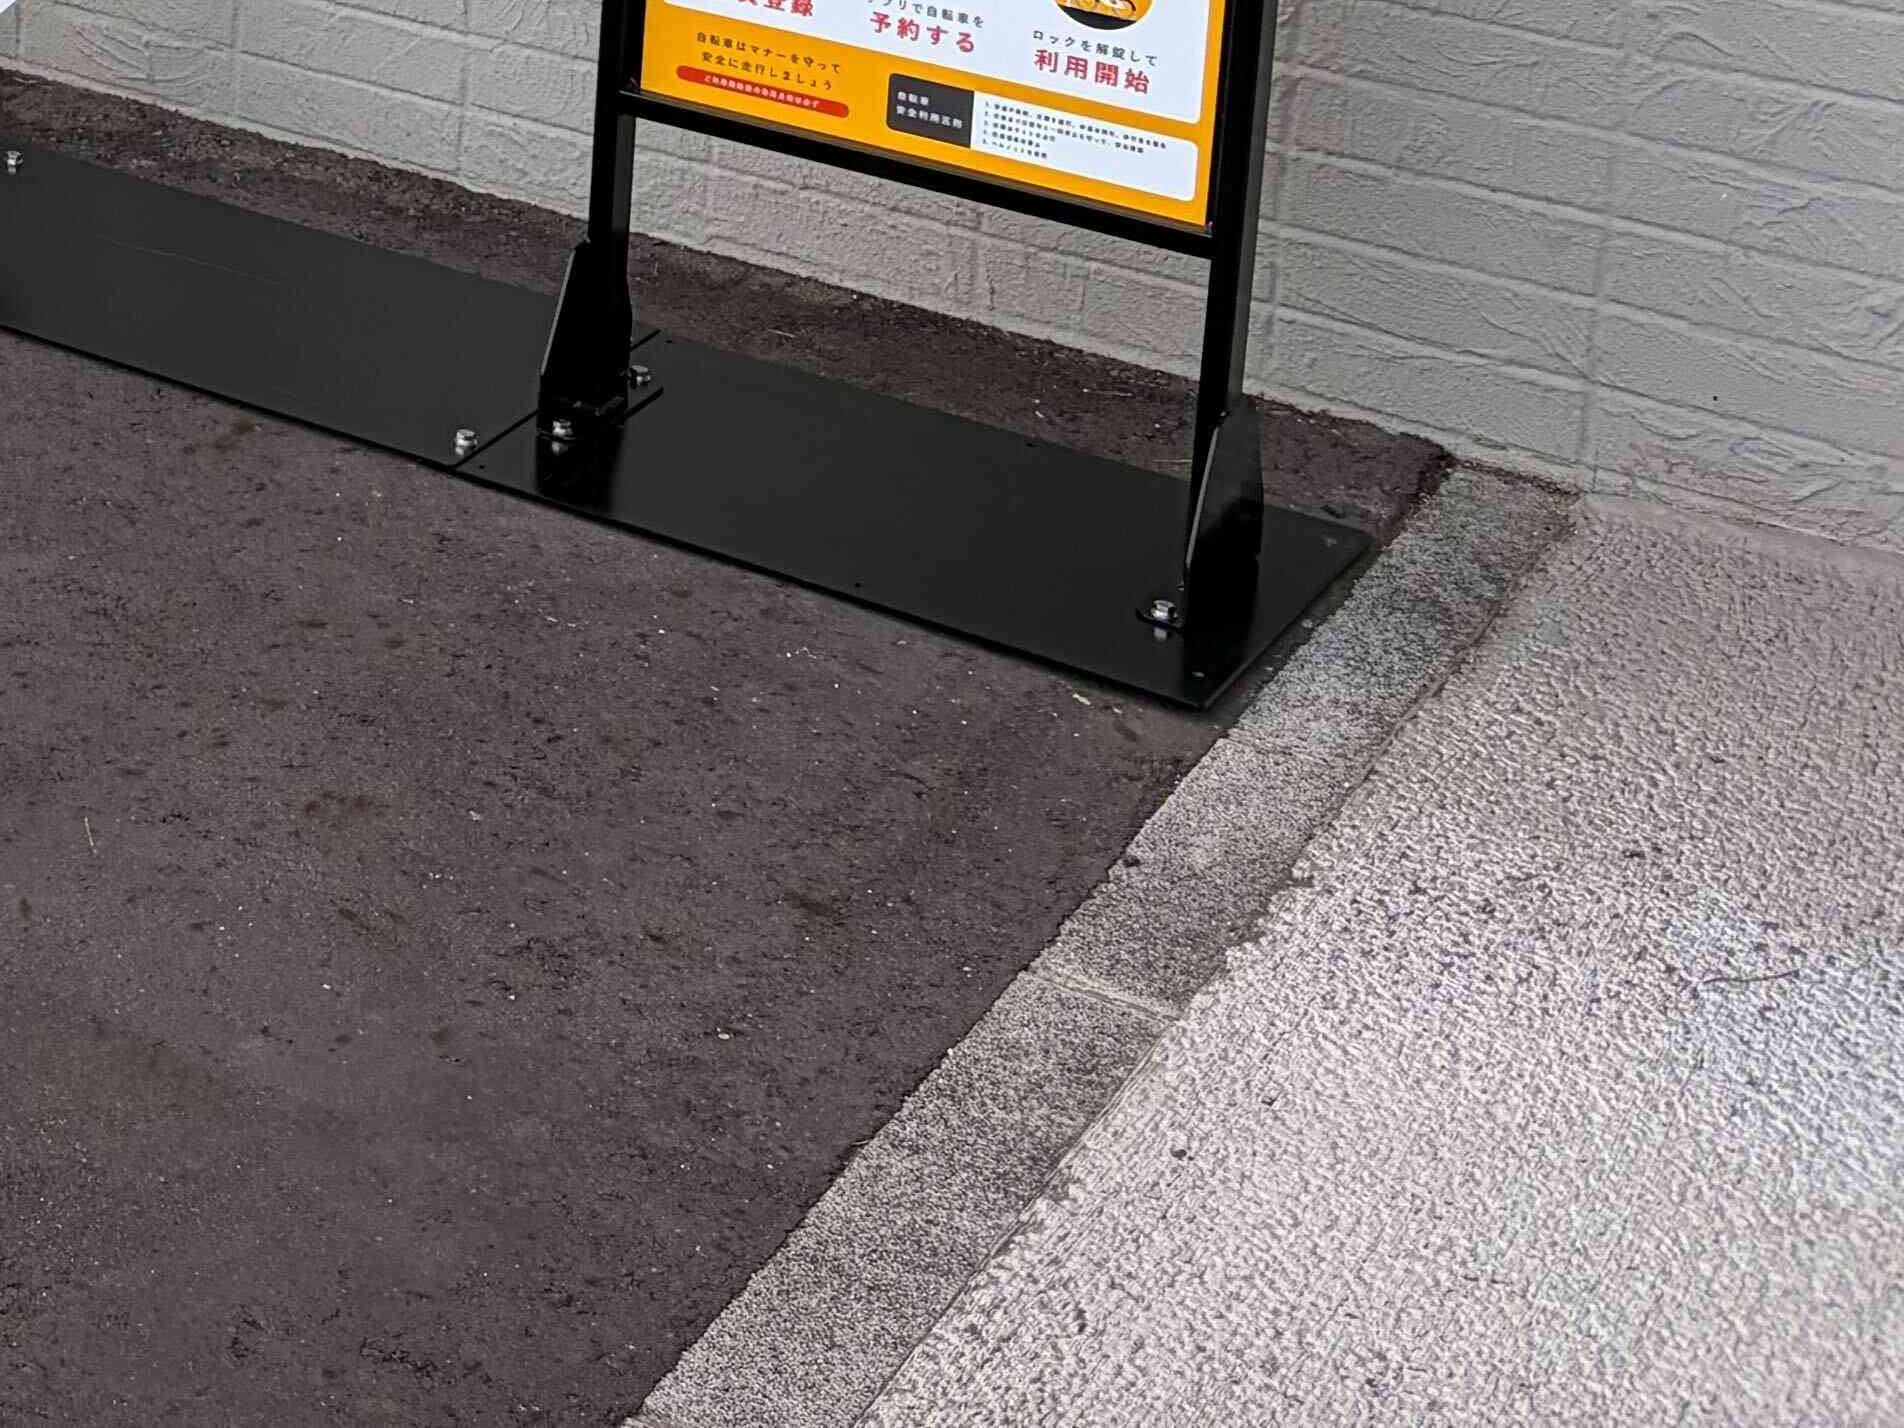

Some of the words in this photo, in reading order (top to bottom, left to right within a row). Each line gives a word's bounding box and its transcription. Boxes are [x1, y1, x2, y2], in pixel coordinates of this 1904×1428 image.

[696, 31, 842, 74] 自転車はマナーを守って
[868, 10, 976, 55] 予約する
[1031, 28, 1159, 66] ロックを解錠して
[701, 51, 833, 90] 安全に走行しましょう
[1032, 48, 1151, 96] 利用開始
